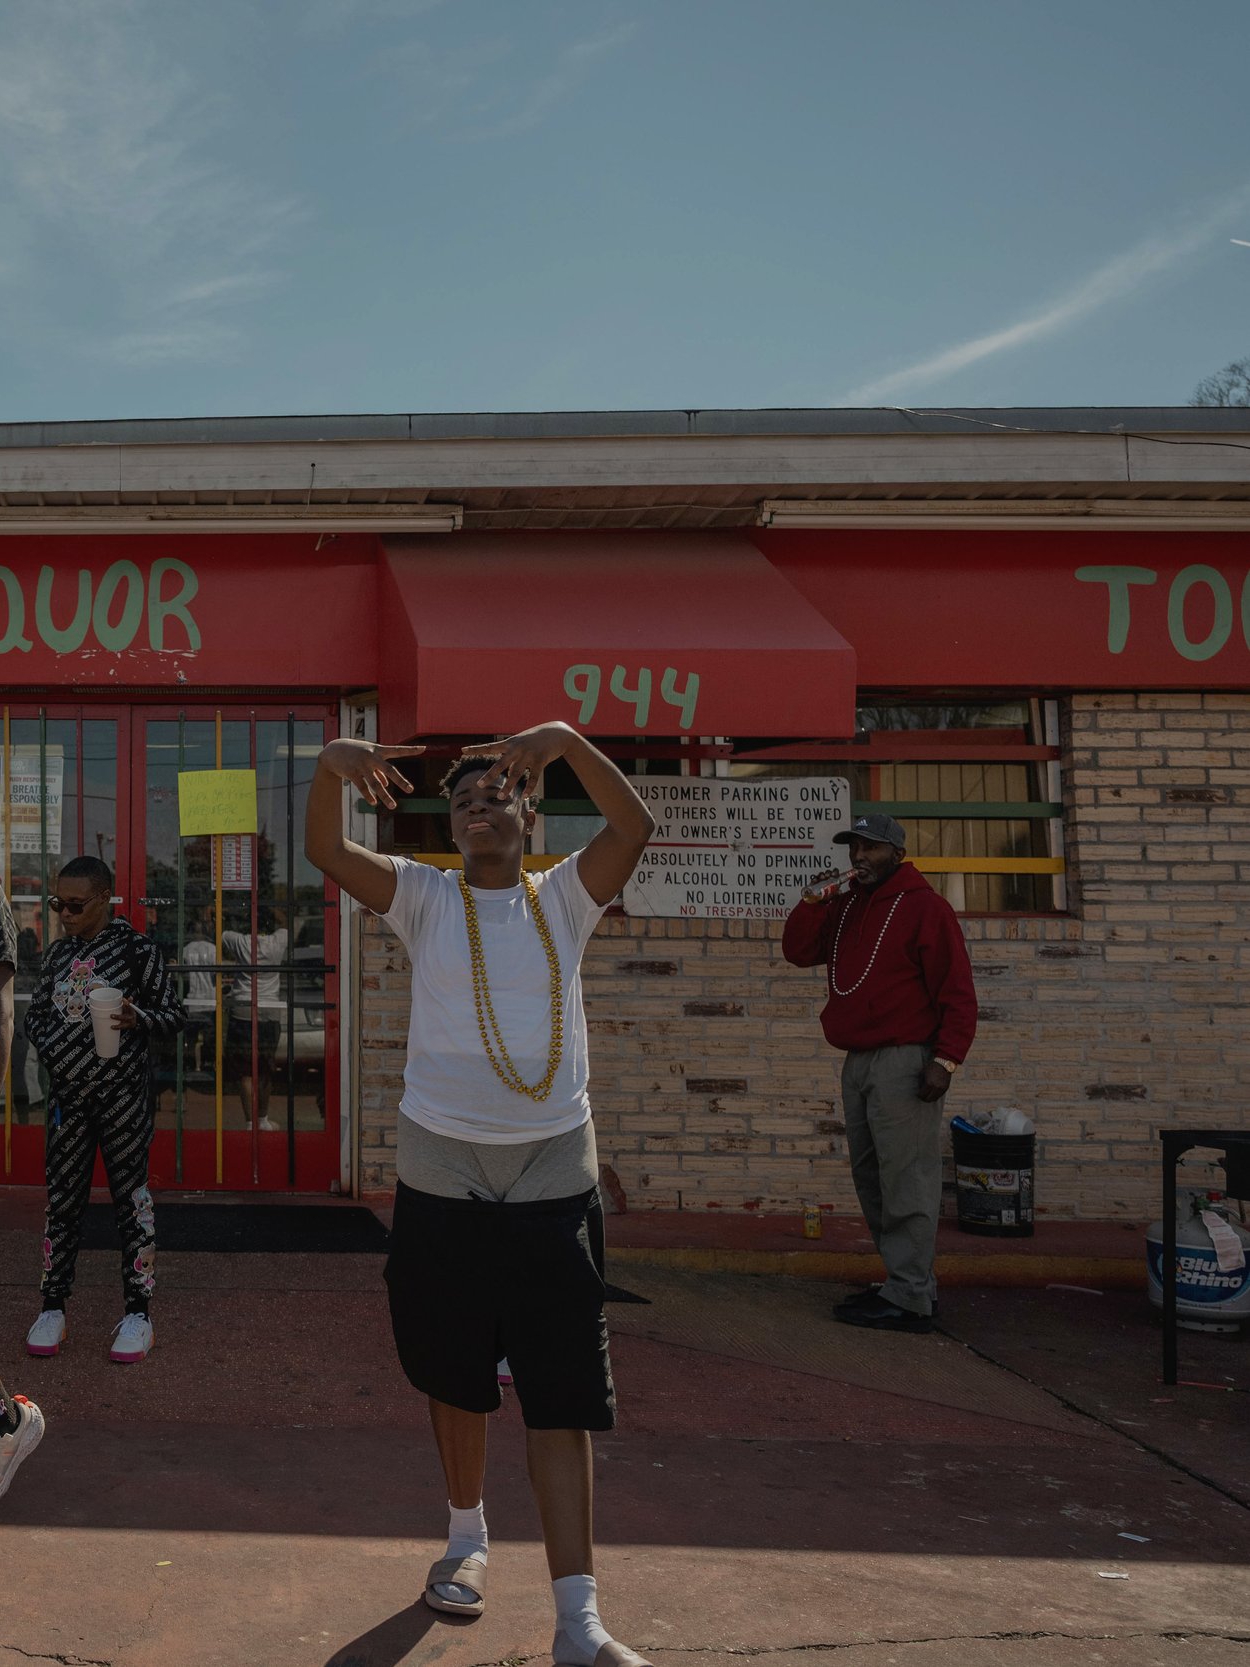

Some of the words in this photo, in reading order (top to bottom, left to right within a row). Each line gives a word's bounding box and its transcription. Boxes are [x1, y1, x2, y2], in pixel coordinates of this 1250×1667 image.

[1074, 563, 1250, 662] TO
[562, 663, 700, 730] 944
[12, 785, 50, 795] BREATE
[721, 787, 789, 801] PARKING
[800, 787, 840, 801] ONLY
[5, 794, 60, 805] ESPONSBLY
[664, 806, 717, 820] OTHERS
[726, 807, 758, 820] WILL
[767, 808, 784, 820] BE
[794, 808, 842, 820] TOWED
[656, 825, 671, 838] AT
[681, 825, 742, 839] OWNER'S
[751, 826, 815, 840] EXPENSE
[641, 852, 728, 867] ABSOLUTELY
[737, 854, 756, 868] NO
[637, 871, 655, 884] OF
[664, 872, 728, 886] ALCOHOL
[737, 873, 756, 887] ON
[765, 874, 810, 888] PREMI
[686, 890, 705, 903] NO
[713, 892, 785, 906] LOITERING
[680, 905, 697, 915] NO
[1180, 1255, 1220, 1273] Blu
[1176, 1271, 1244, 1289] Rhino
